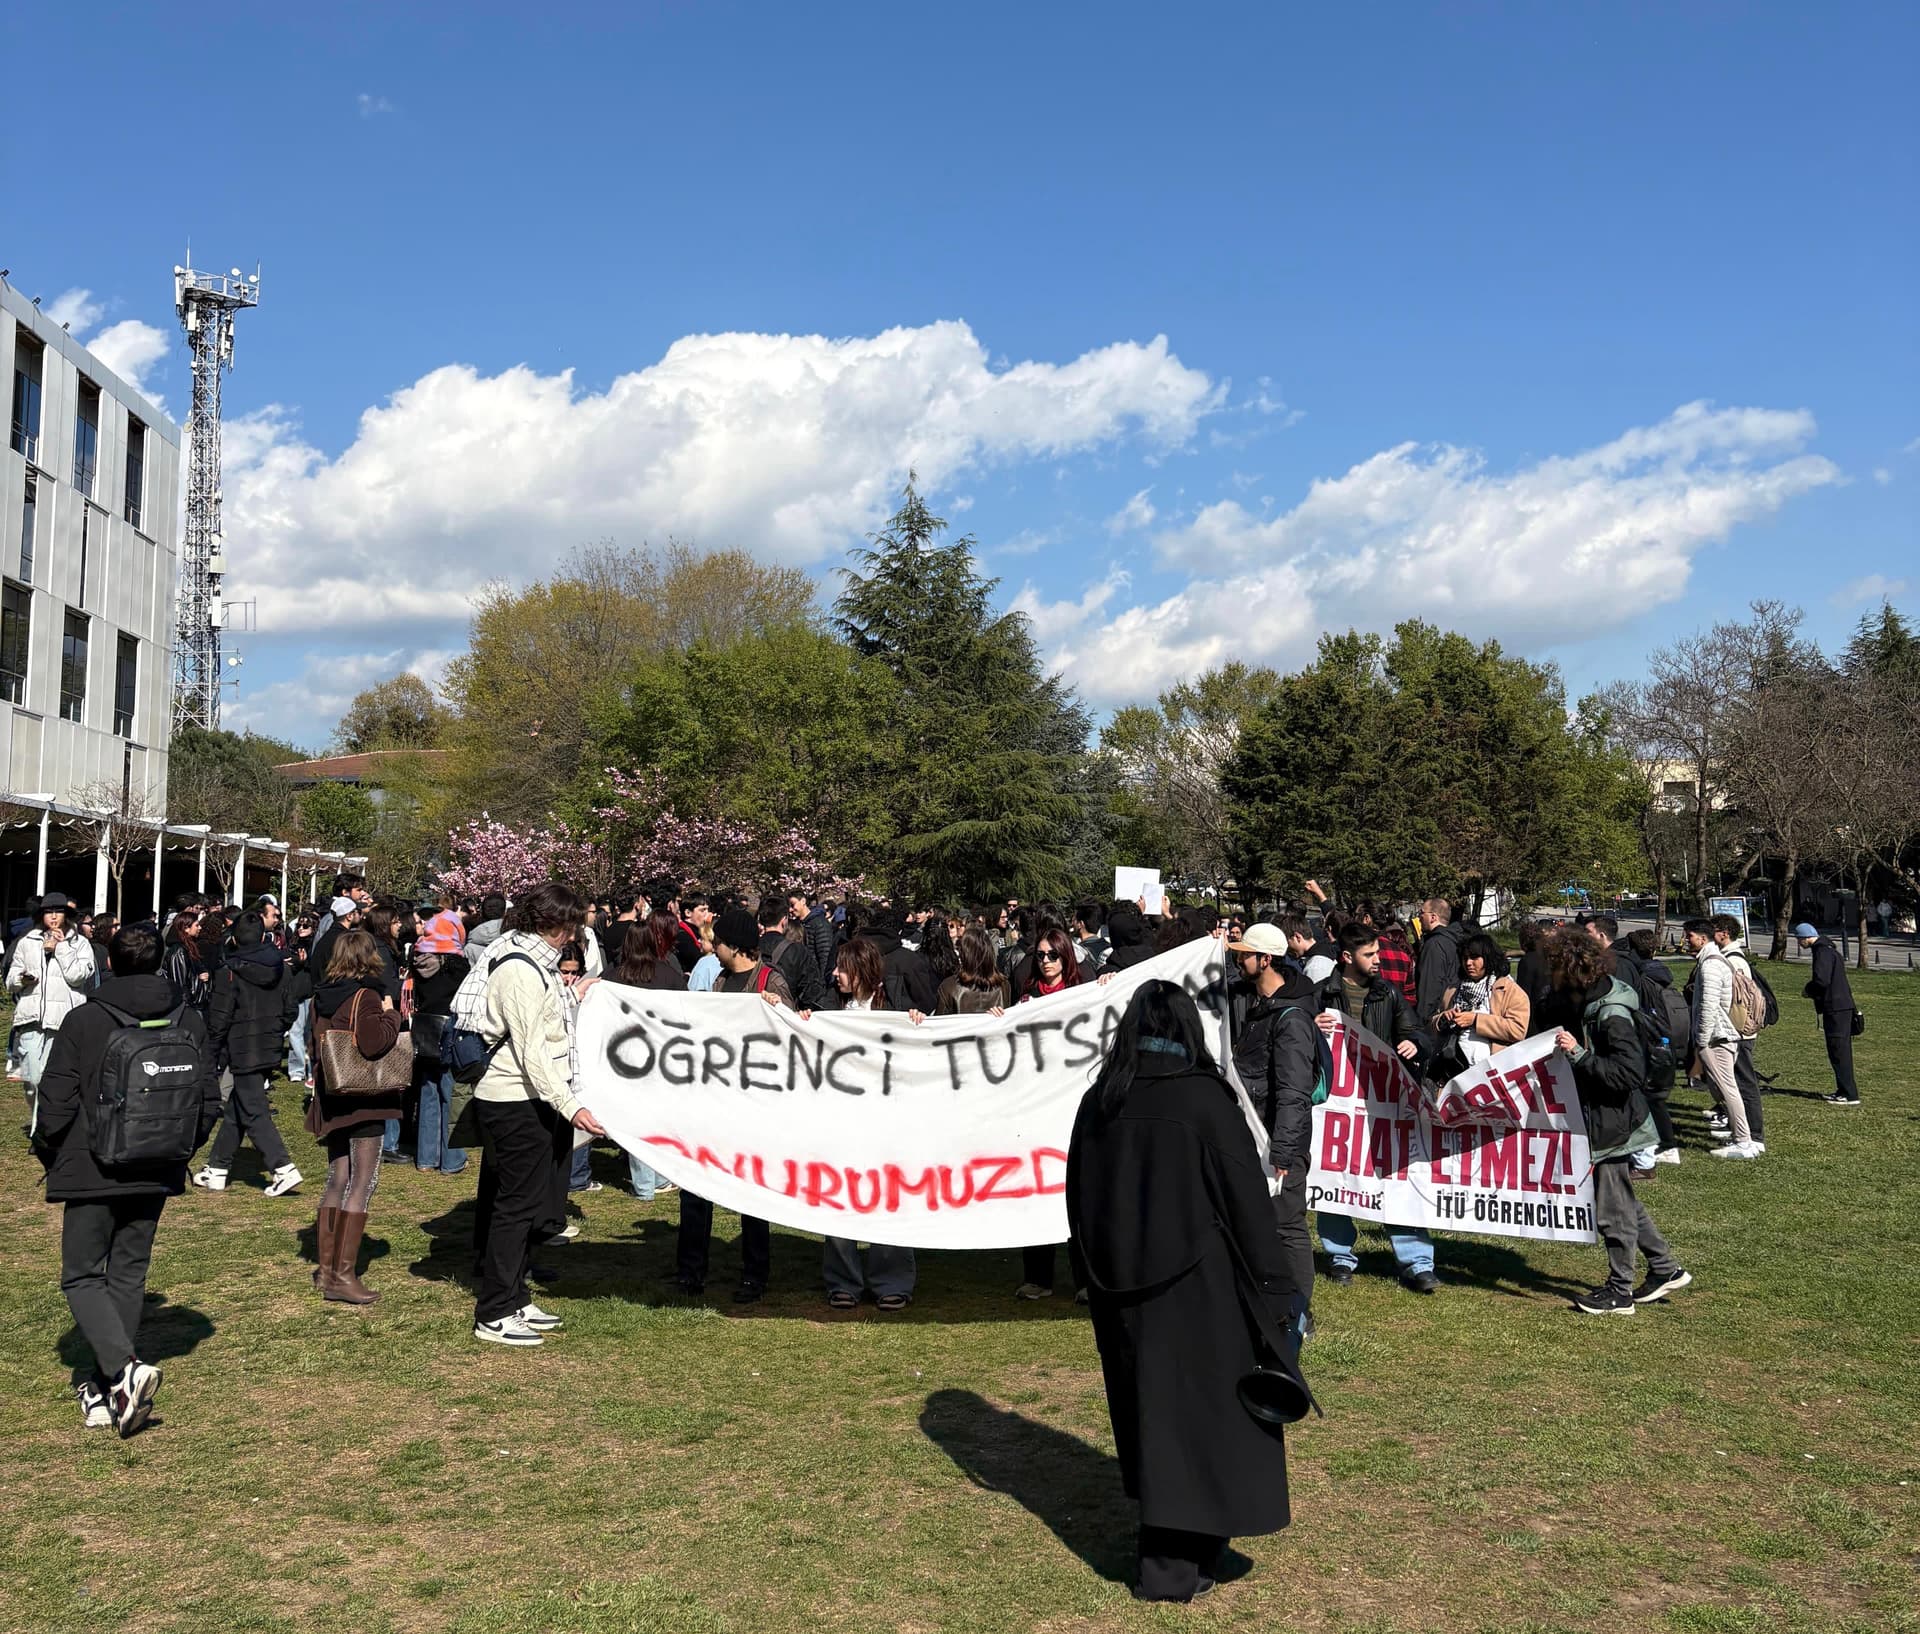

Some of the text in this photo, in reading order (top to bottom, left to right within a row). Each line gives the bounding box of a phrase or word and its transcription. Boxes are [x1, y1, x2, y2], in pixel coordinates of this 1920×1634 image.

[606, 1001, 893, 1096] ÖĞRENCİ
[1320, 1106, 1415, 1181] BİAT
[1431, 1124, 1576, 1195] ETMEZ!
[1436, 1190, 1594, 1232] İTÜ ÖĞRENCİLERİ
